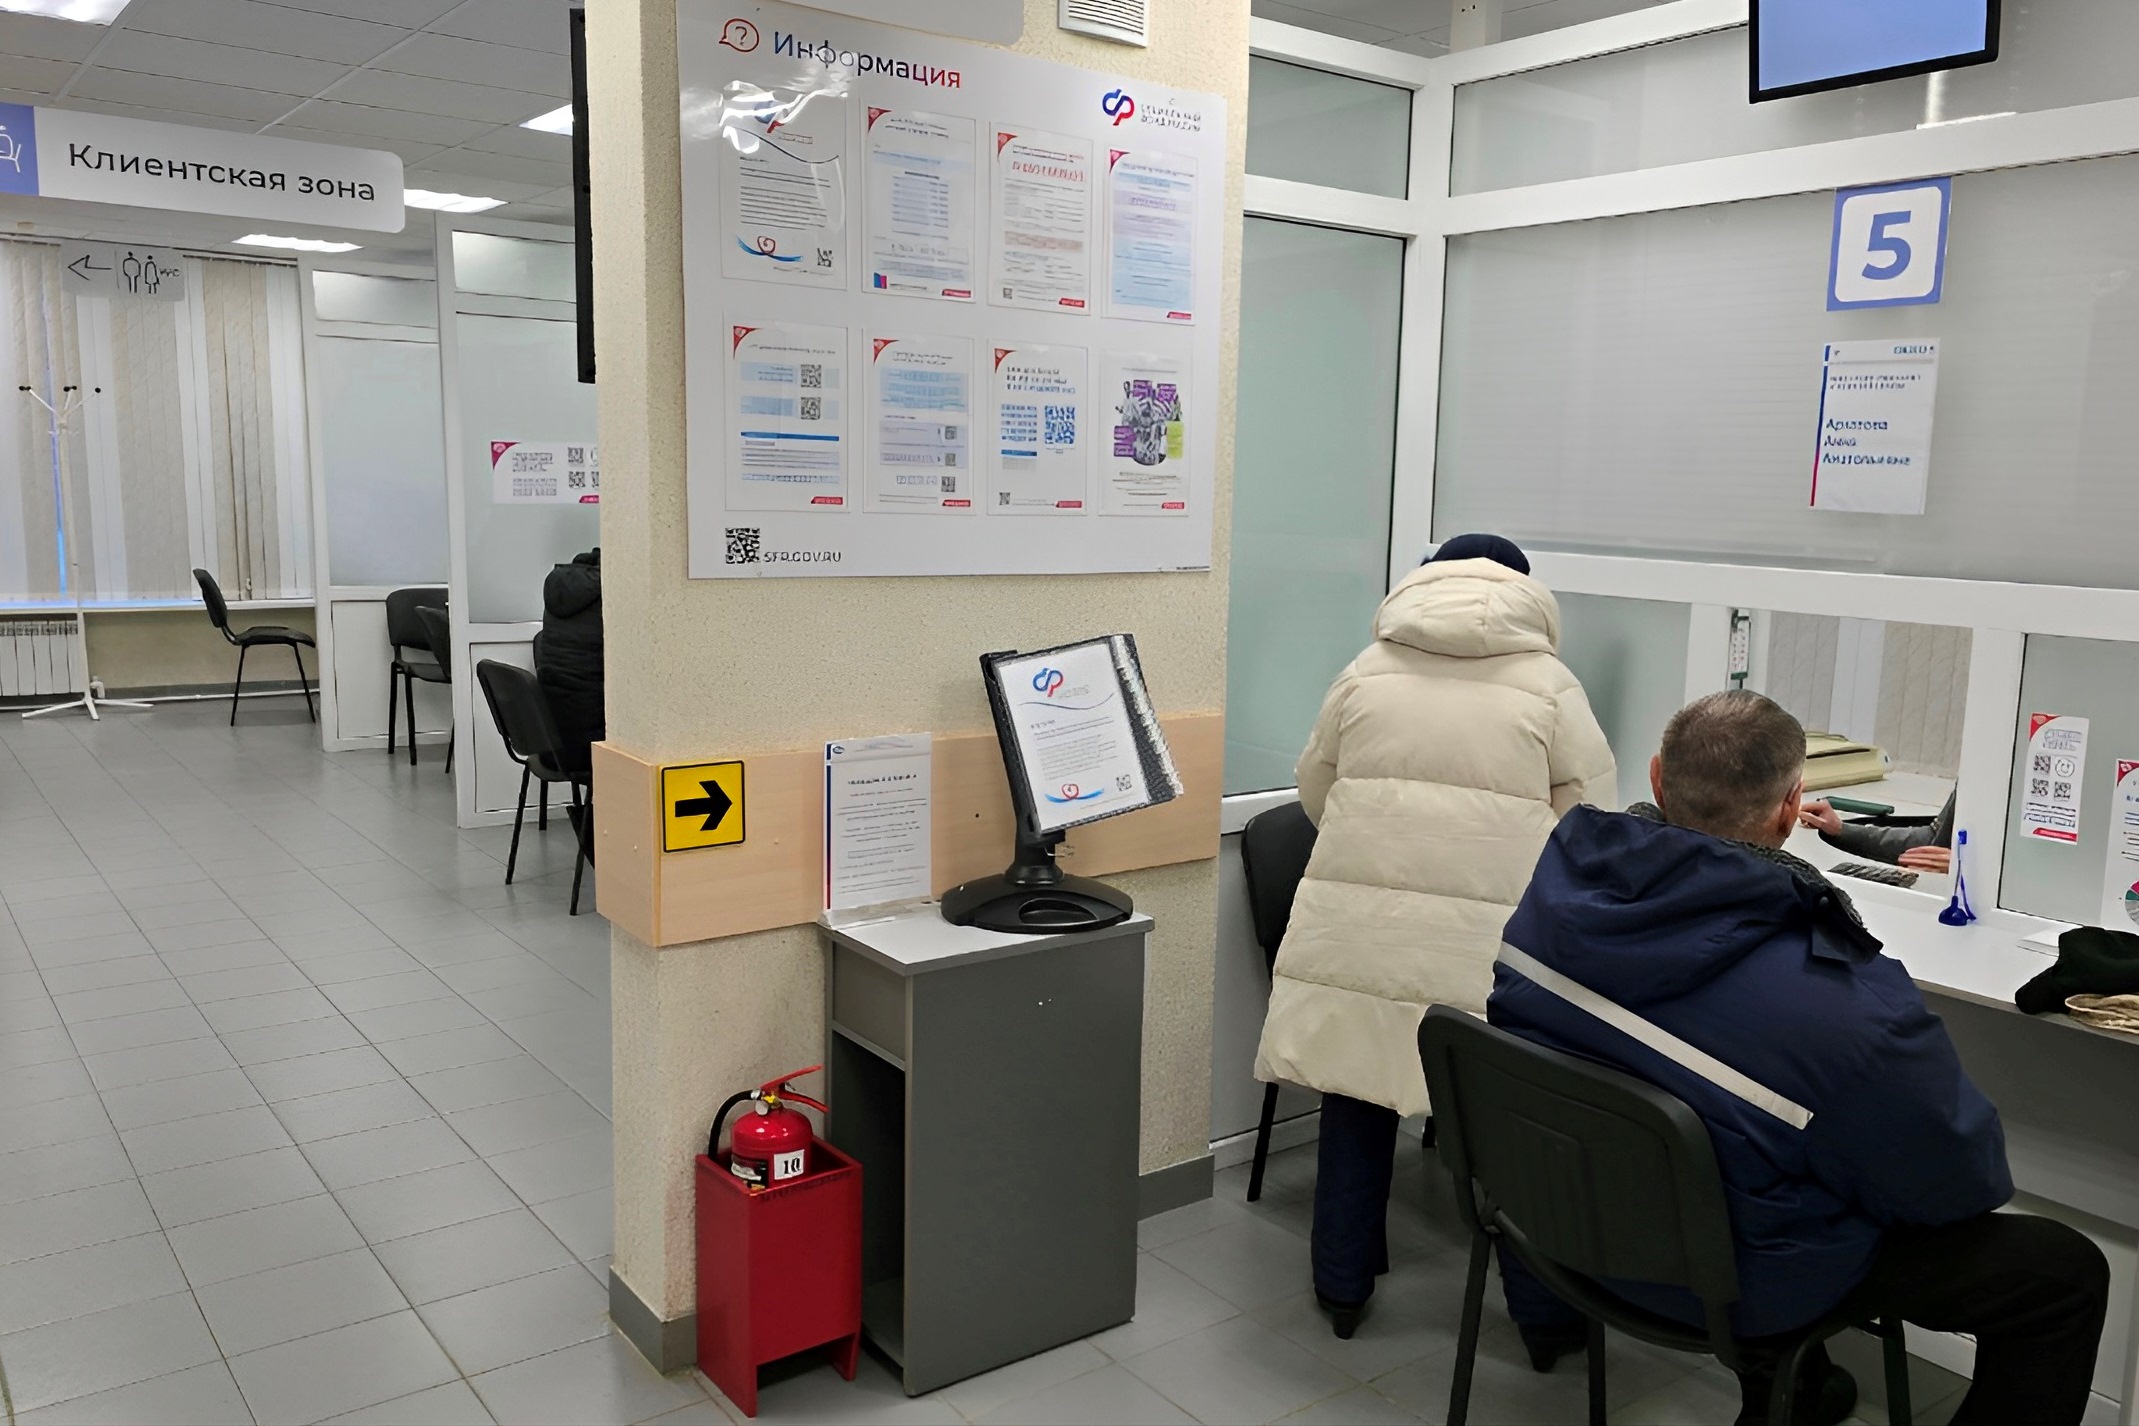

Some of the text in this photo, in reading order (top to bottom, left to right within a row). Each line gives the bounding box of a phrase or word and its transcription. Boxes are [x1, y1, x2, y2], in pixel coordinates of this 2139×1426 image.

[774, 31, 960, 88] Информация
[69, 143, 375, 201] Клиентская зона
[1861, 210, 1912, 281] 5
[783, 1157, 801, 1174] 10
